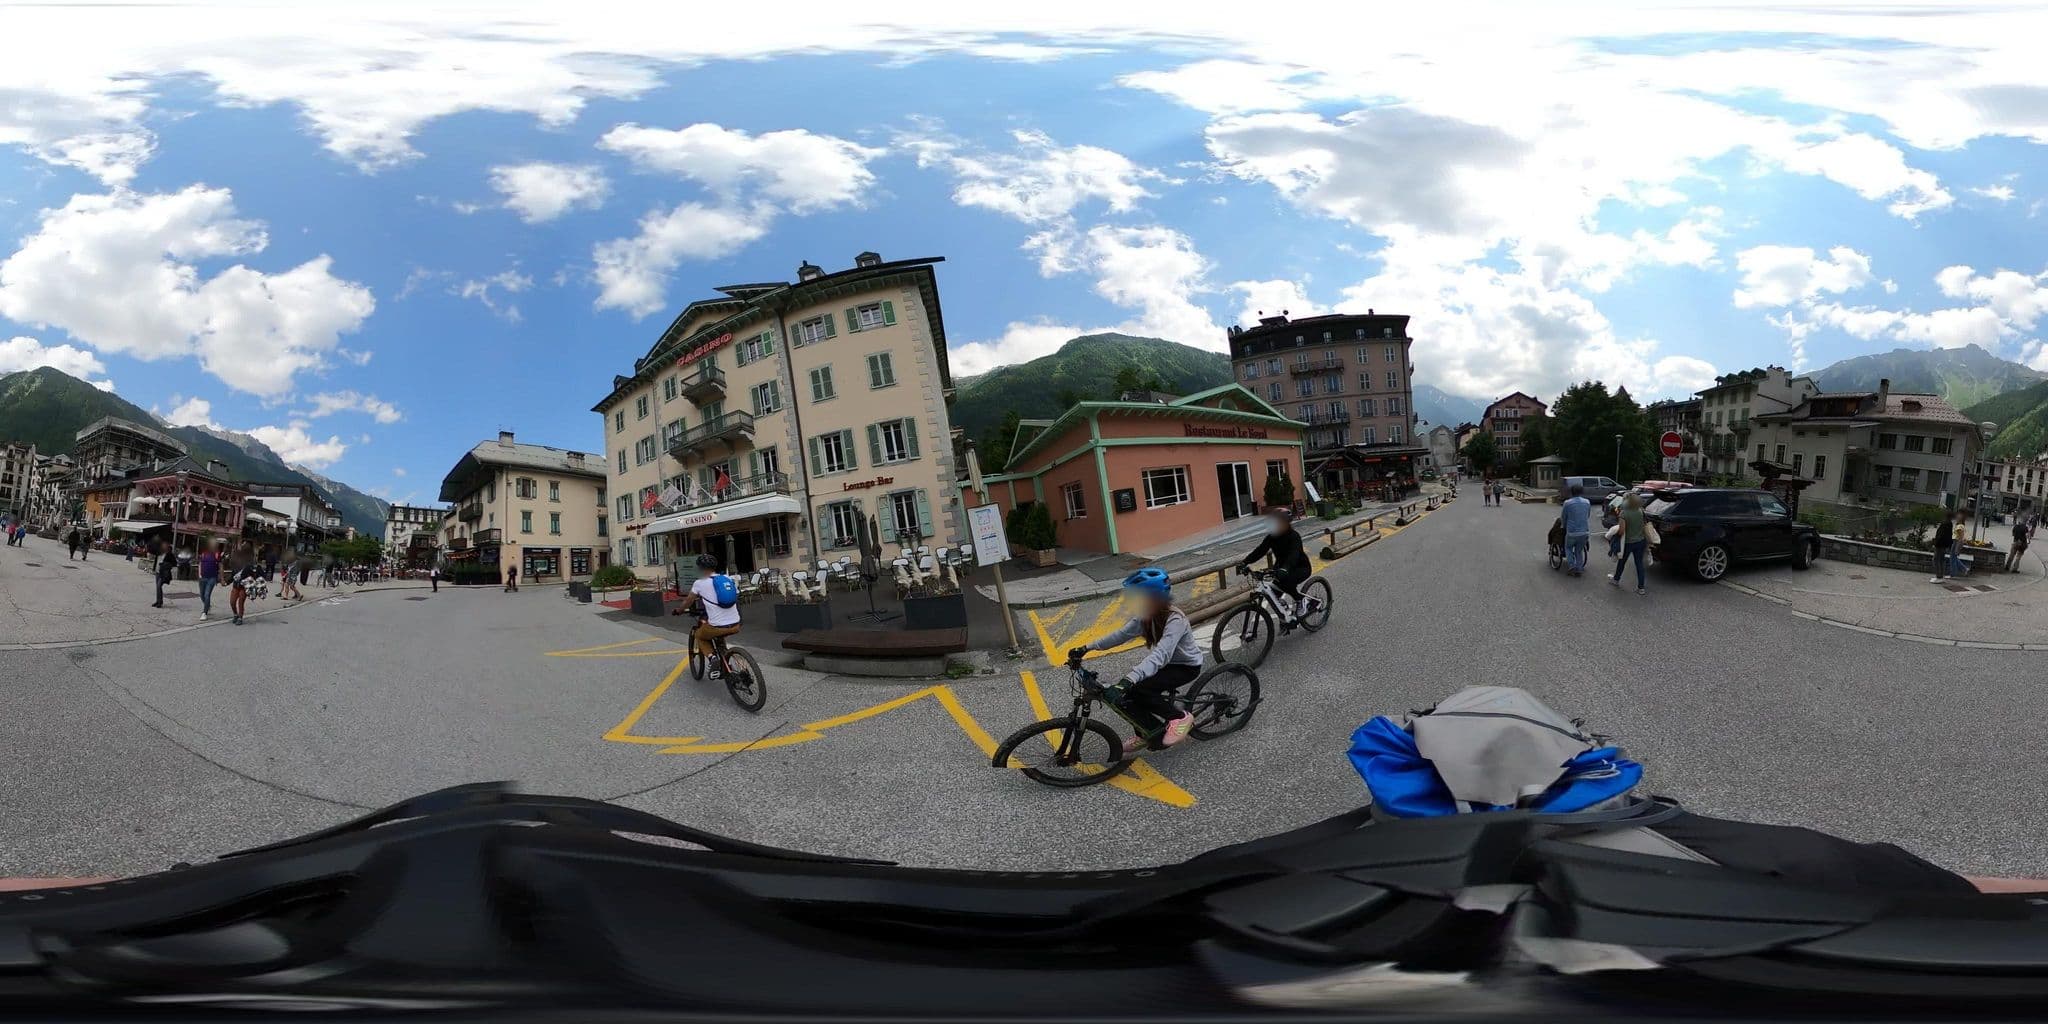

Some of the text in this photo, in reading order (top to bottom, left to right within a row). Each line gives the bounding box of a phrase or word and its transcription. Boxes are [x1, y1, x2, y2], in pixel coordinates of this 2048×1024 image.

[677, 333, 732, 366] CASINO
[1184, 423, 1236, 438] Restaurant
[843, 477, 894, 490] Lounge Bar
[685, 514, 712, 525] CASINO
